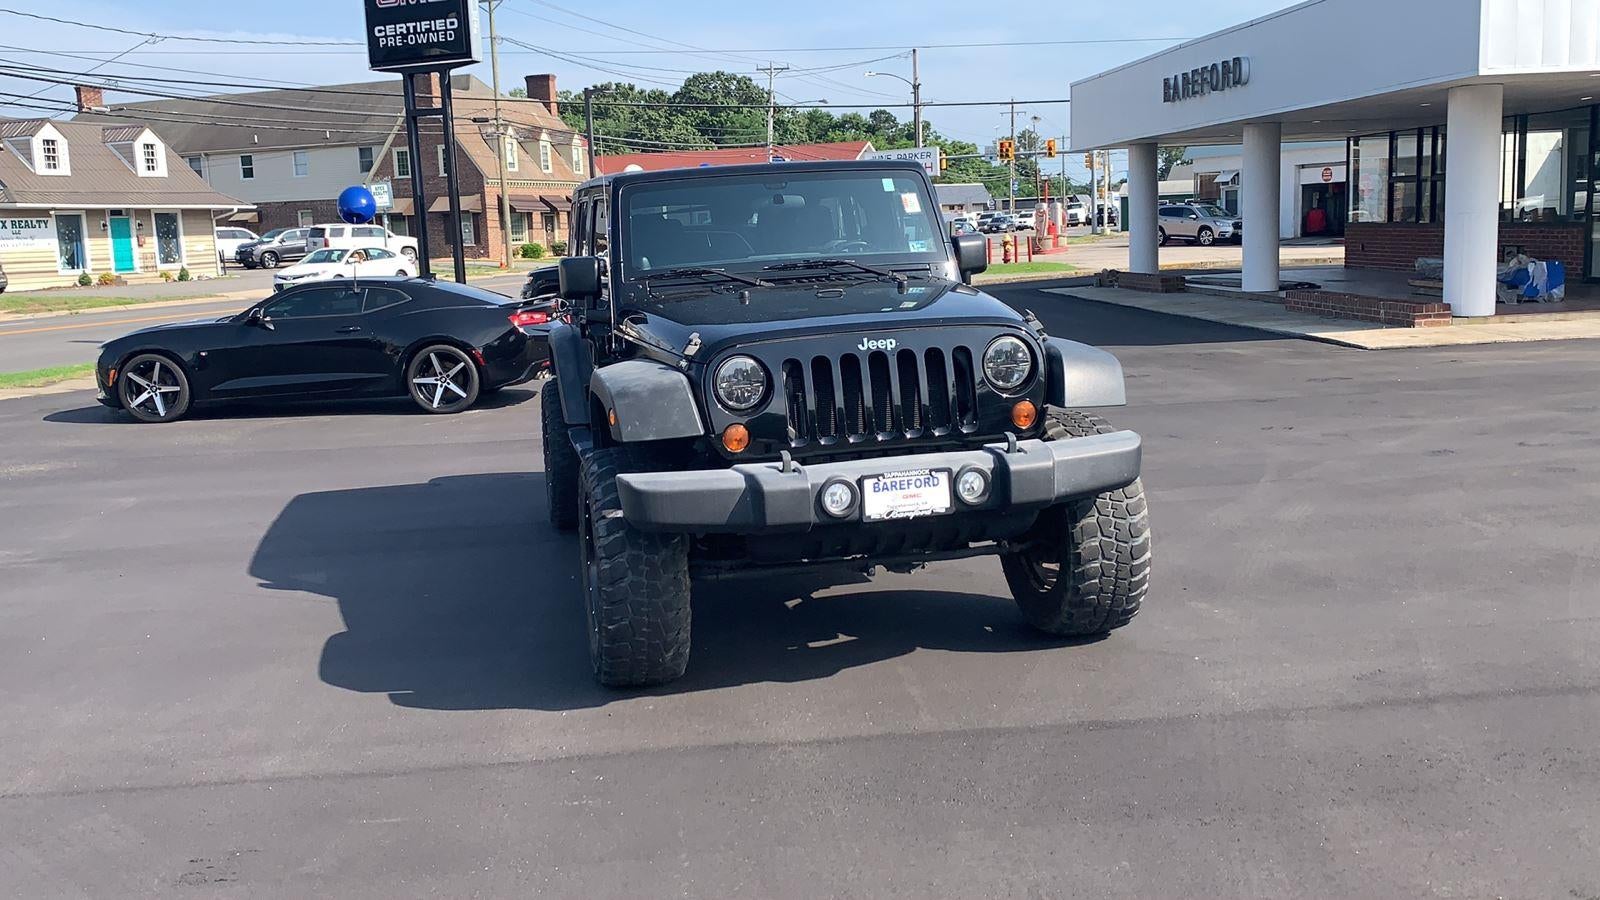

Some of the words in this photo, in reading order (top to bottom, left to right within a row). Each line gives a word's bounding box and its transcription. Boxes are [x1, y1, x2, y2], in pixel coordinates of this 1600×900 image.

[374, 18, 458, 37] CERTIFIED
[379, 30, 455, 48] PRE-OWNED
[1163, 56, 1250, 103] BAREFORD
[896, 151, 932, 160] PARKER
[10, 219, 49, 229] REALTY
[857, 337, 896, 351] Jeep
[872, 476, 940, 493] BAREFORD
[902, 492, 922, 500] GMC
